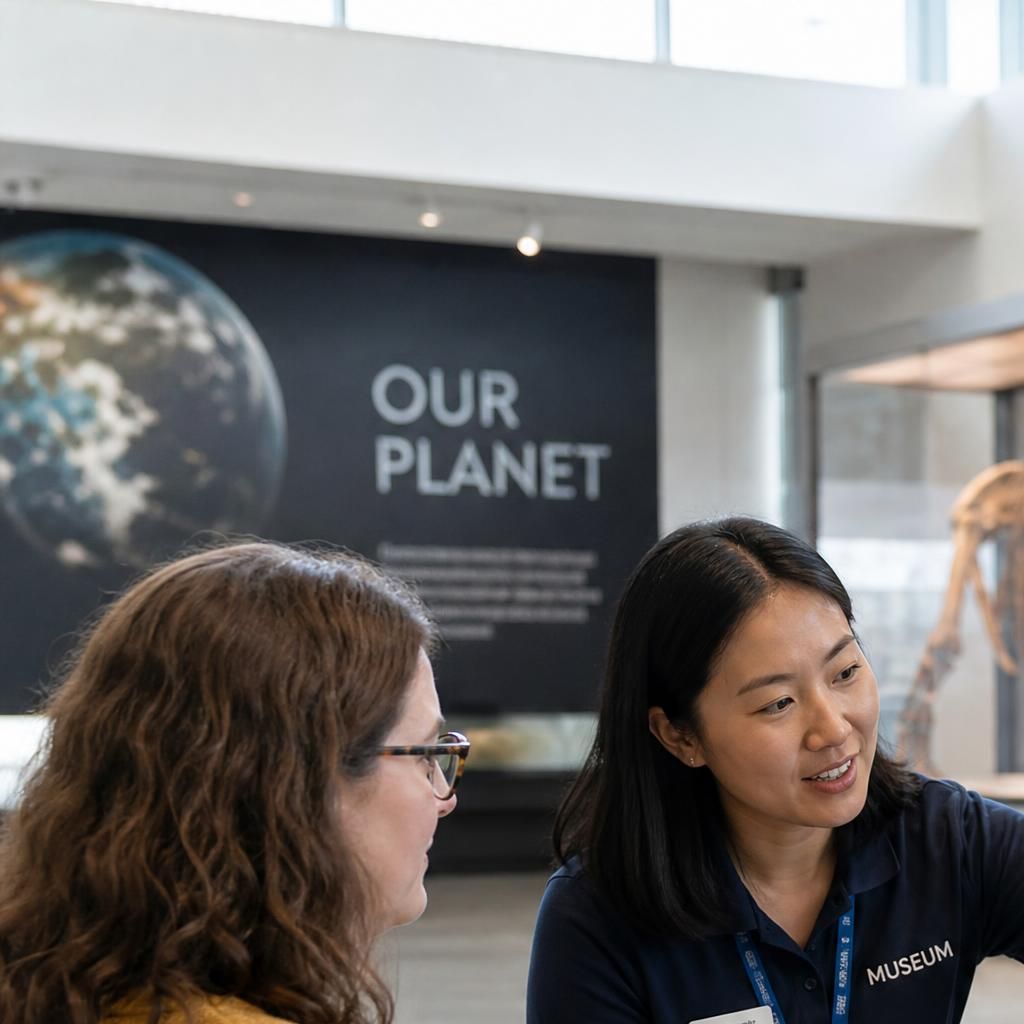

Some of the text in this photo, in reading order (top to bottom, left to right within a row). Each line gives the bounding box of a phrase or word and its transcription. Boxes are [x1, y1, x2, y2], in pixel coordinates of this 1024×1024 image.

[371, 363, 520, 429] OUR
[374, 434, 611, 500] PLANET
[867, 940, 954, 986] MUSEUM
